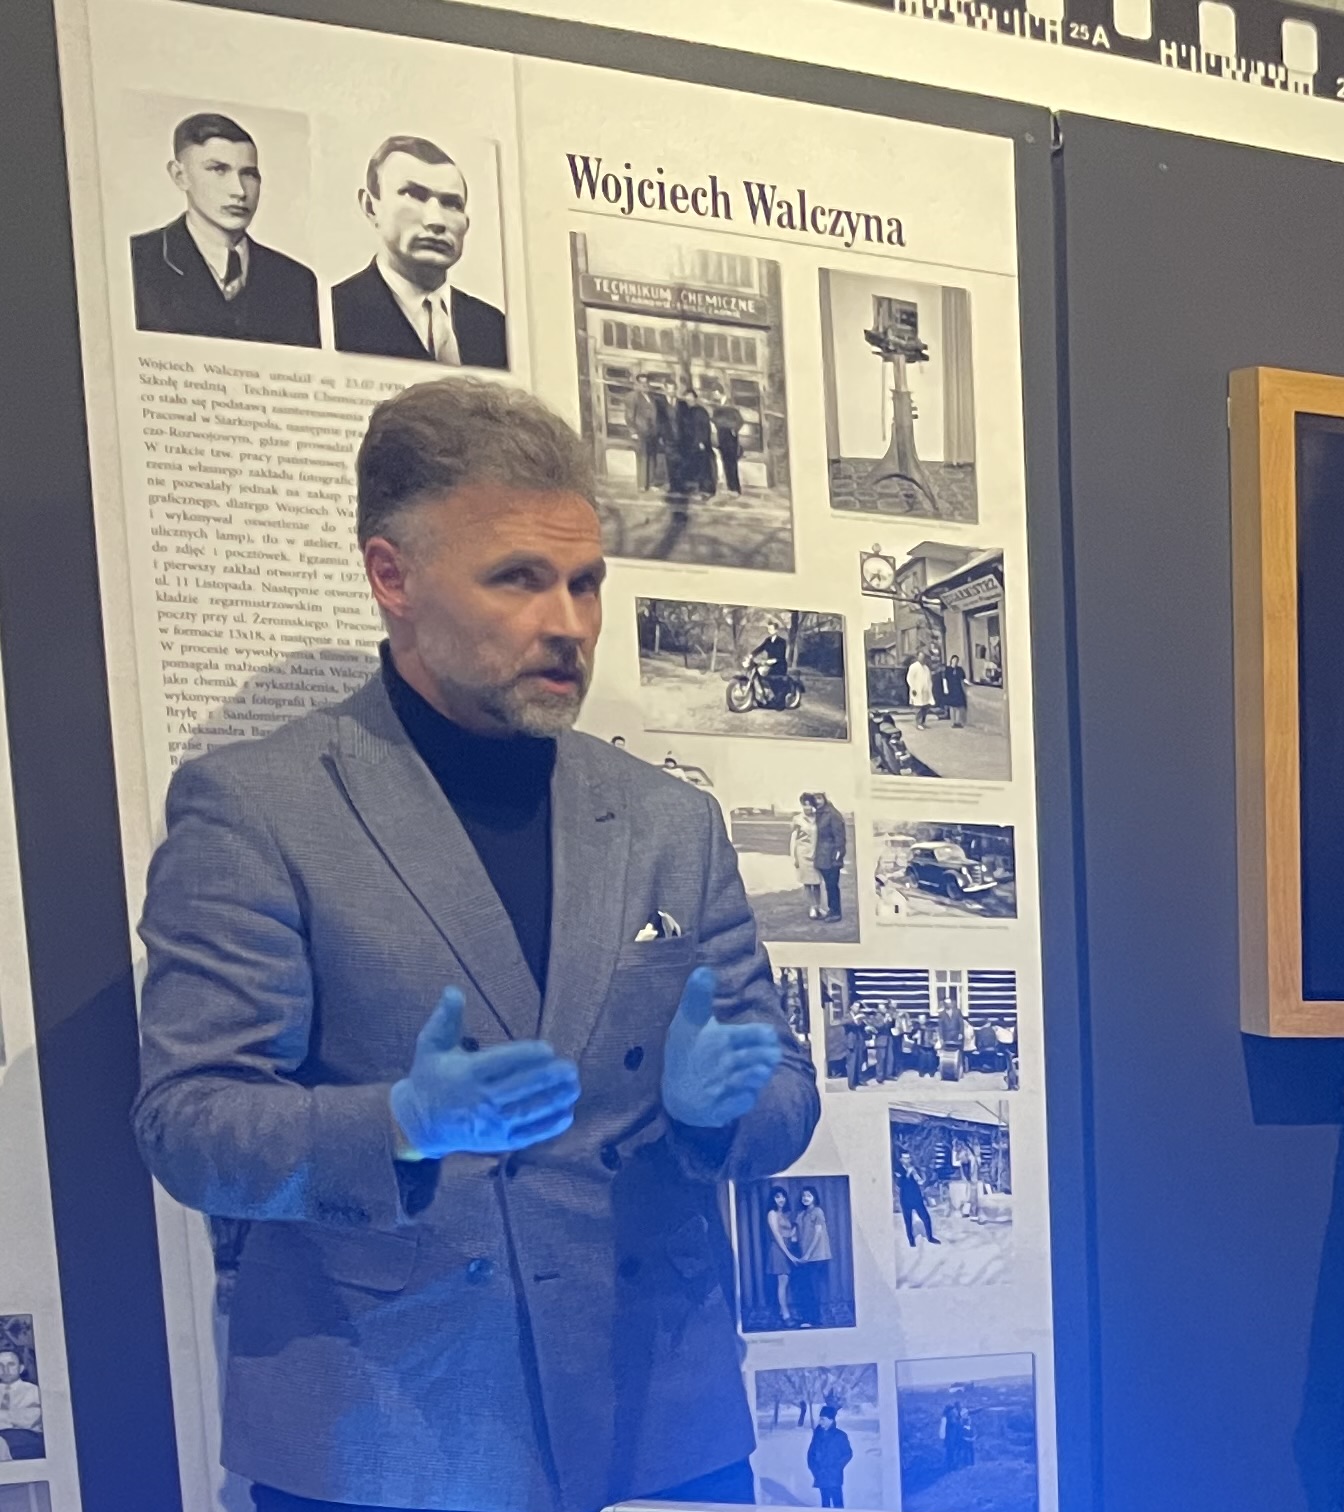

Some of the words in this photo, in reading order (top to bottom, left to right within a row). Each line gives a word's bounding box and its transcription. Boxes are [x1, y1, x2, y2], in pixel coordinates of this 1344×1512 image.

[566, 153, 733, 221] Wojciech
[743, 180, 906, 248] Walczyna
[594, 277, 672, 302] TECHNIKUM
[681, 289, 756, 313] CHEMICZNE
[138, 356, 194, 373] Wojciech
[203, 363, 260, 379] Walczyna
[139, 373, 178, 391] Szkołę
[183, 379, 226, 396] średnią
[244, 384, 309, 400] Technikum
[140, 393, 154, 403] co
[159, 393, 188, 405] stało
[211, 400, 267, 415] podstawą
[142, 407, 197, 423] Pracował
[201, 415, 211, 424] w
[144, 440, 159, 452] W
[164, 444, 206, 457] trakcie
[239, 452, 273, 465] pracy
[188, 461, 243, 479] własnego
[248, 468, 294, 481] zakładu
[147, 476, 166, 487] nie
[172, 478, 232, 495] pozwalały
[239, 484, 279, 496] jednak
[225, 497, 270, 514] dlatego
[275, 501, 329, 517] Wojciech
[165, 509, 233, 526] wykonywał
[321, 521, 337, 533] do
[150, 524, 208, 541] ulicznych
[262, 533, 279, 545] tło
[286, 537, 296, 546] w
[151, 540, 168, 553] do
[175, 543, 206, 558] zdjęć
[299, 552, 349, 567] Egzamin
[163, 560, 217, 576] pierwszy
[223, 563, 261, 577] zakład
[266, 566, 318, 581] otworzył
[323, 573, 333, 581] w
[176, 575, 189, 588] 11
[261, 581, 320, 598] Następnie
[155, 590, 199, 605] kładzie
[208, 596, 323, 613] zegarmistrzowskim
[333, 604, 361, 616] pana
[157, 610, 197, 623] poczty
[202, 612, 228, 626] przy
[158, 626, 169, 635] w
[173, 624, 224, 639] formacie
[269, 633, 277, 643] a
[161, 640, 174, 652] W
[180, 643, 230, 656] procesie
[161, 658, 219, 674] pomagała
[290, 663, 326, 677] Maria
[162, 672, 189, 688] jako
[193, 674, 238, 688] chemik
[164, 691, 247, 706] wykonywania
[178, 722, 247, 738] Aleksandra
